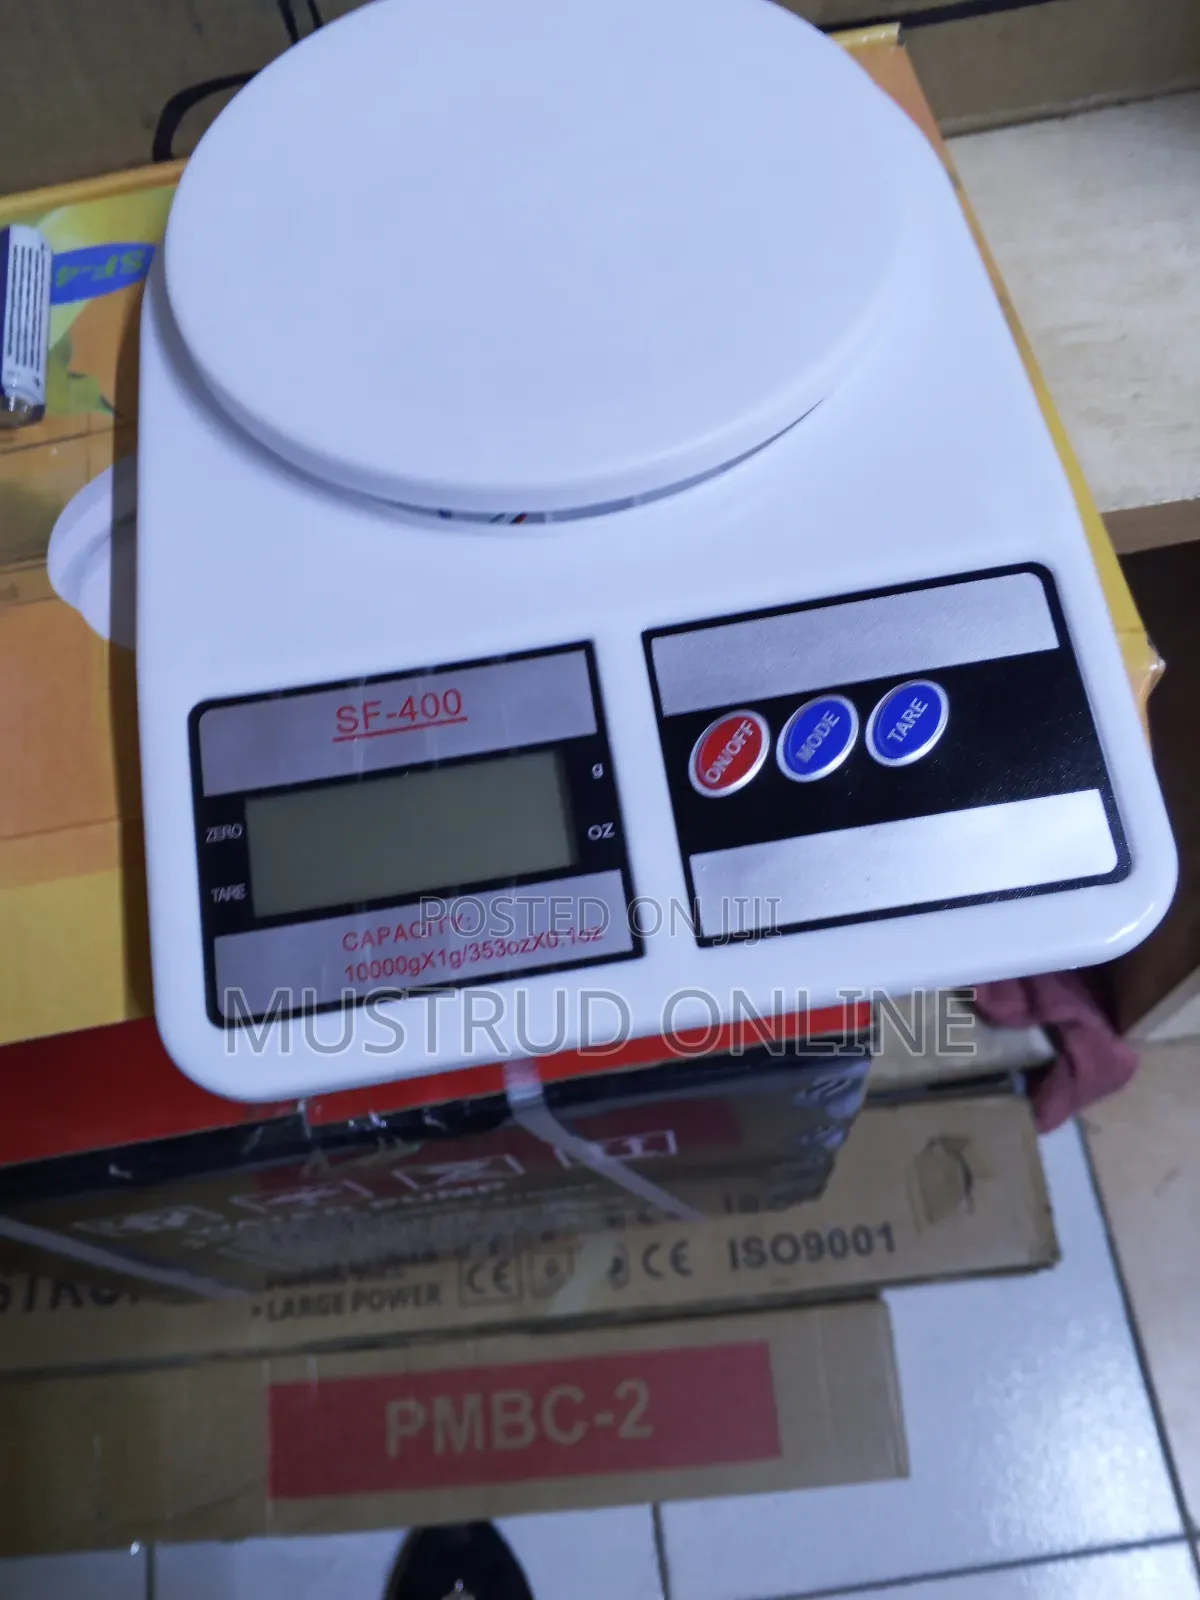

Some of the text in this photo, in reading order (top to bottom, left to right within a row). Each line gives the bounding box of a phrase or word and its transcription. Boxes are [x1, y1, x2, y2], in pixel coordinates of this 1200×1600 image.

[335, 688, 463, 734] SF-400
[887, 697, 929, 743] TARE
[705, 719, 753, 784] ON/OFF
[796, 709, 841, 764] MODE
[591, 763, 604, 780] g
[205, 823, 243, 843] ZERO
[211, 883, 247, 904] TARE
[342, 912, 473, 951] CAPACITY:
[727, 1220, 896, 1271] ISO9001
[385, 1377, 654, 1460] PMBC-2
